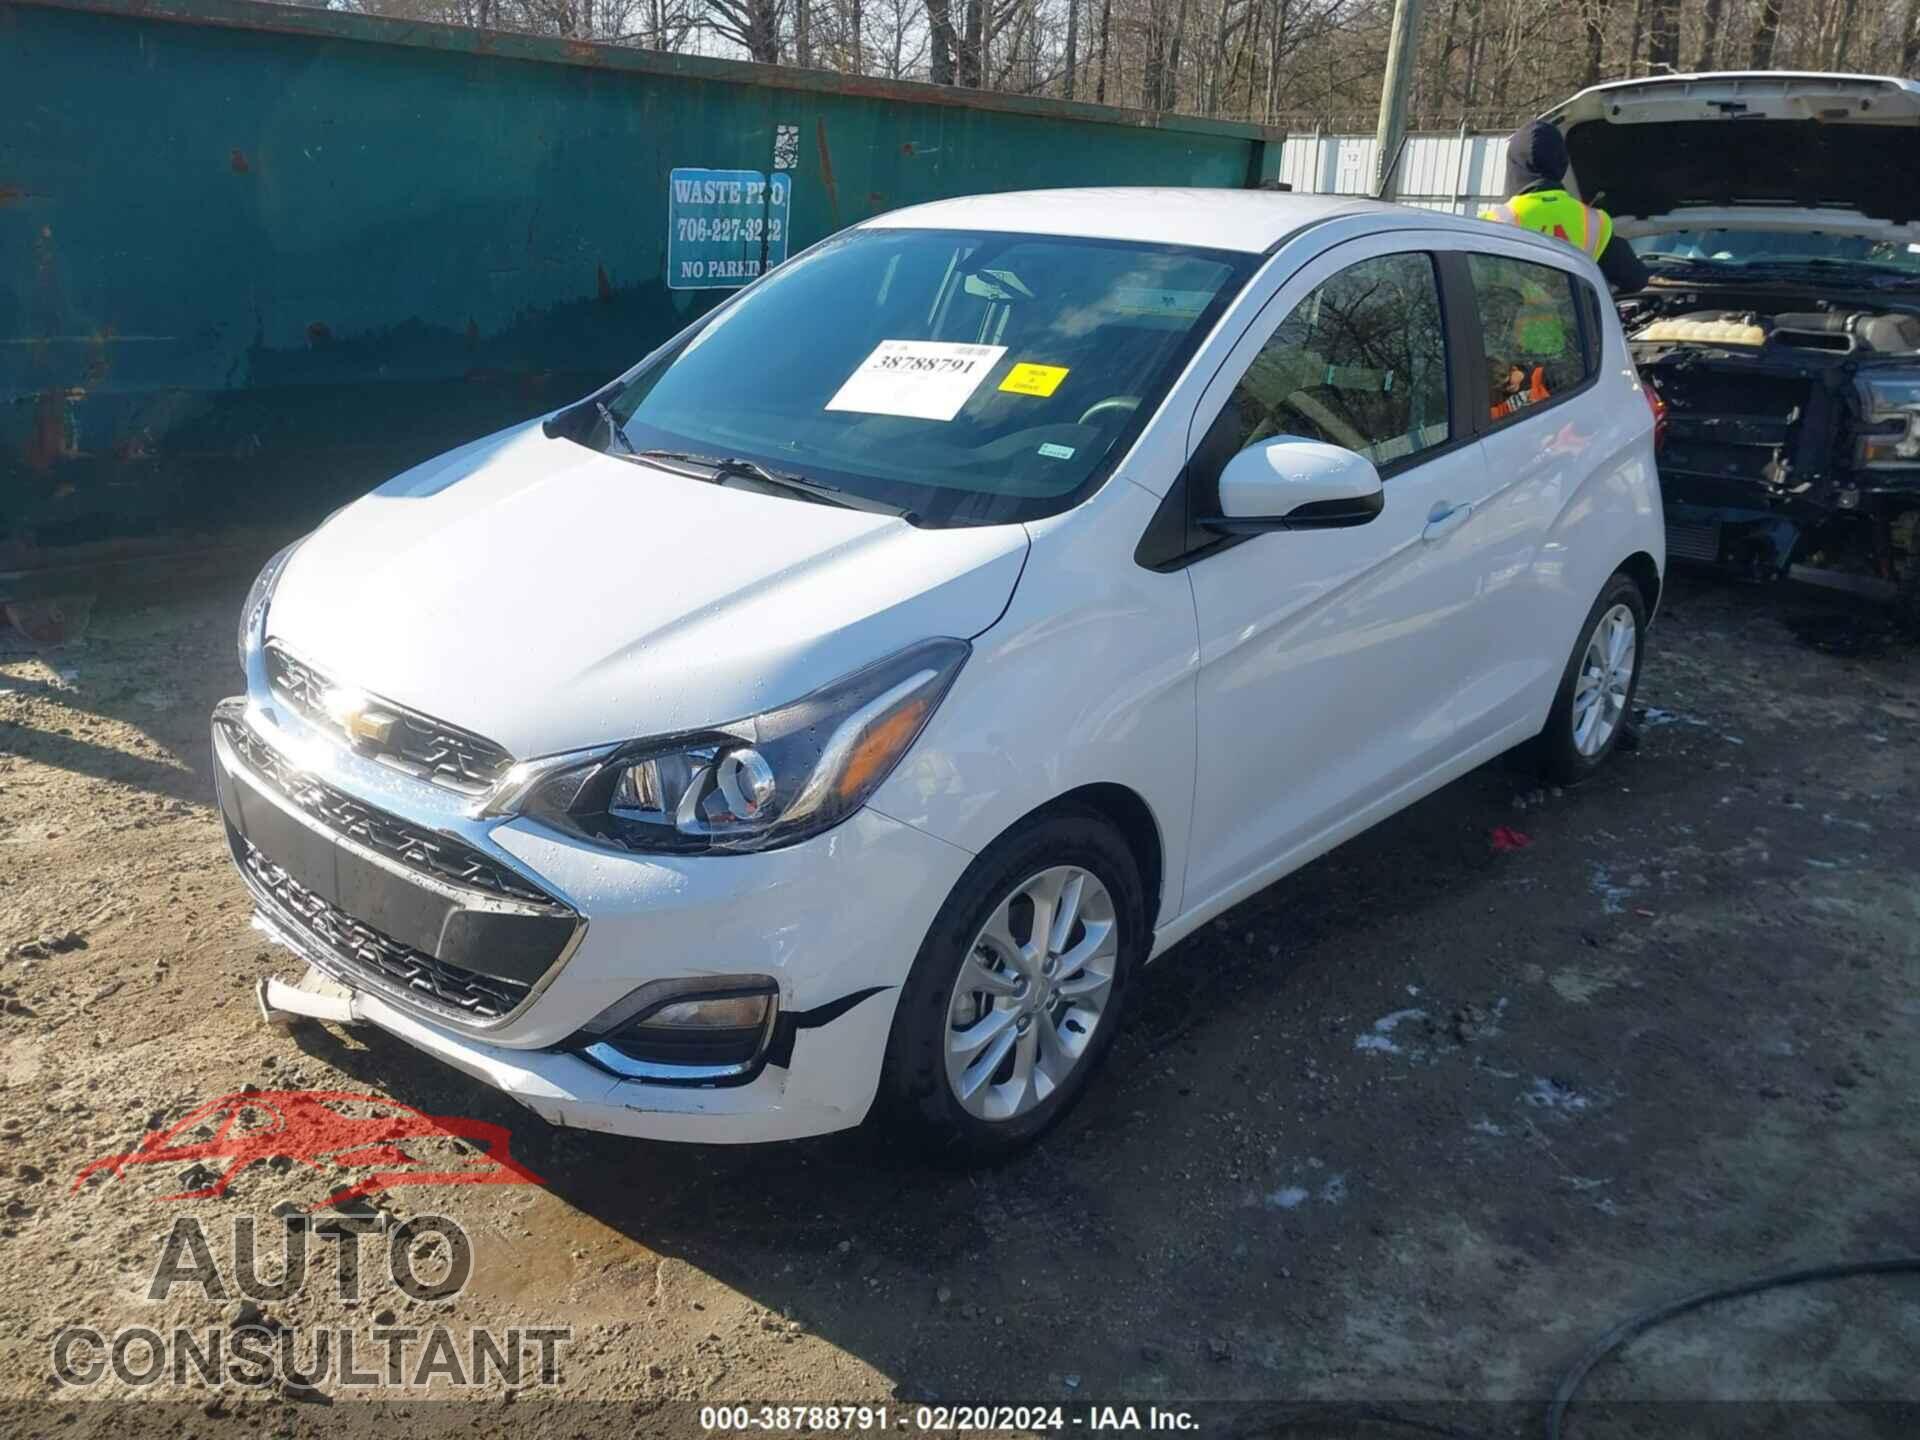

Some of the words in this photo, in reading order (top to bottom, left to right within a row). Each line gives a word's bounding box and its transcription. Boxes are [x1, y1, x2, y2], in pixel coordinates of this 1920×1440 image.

[674, 180, 740, 204] WASTE
[681, 261, 704, 278] NO
[873, 355, 978, 374] 38788791
